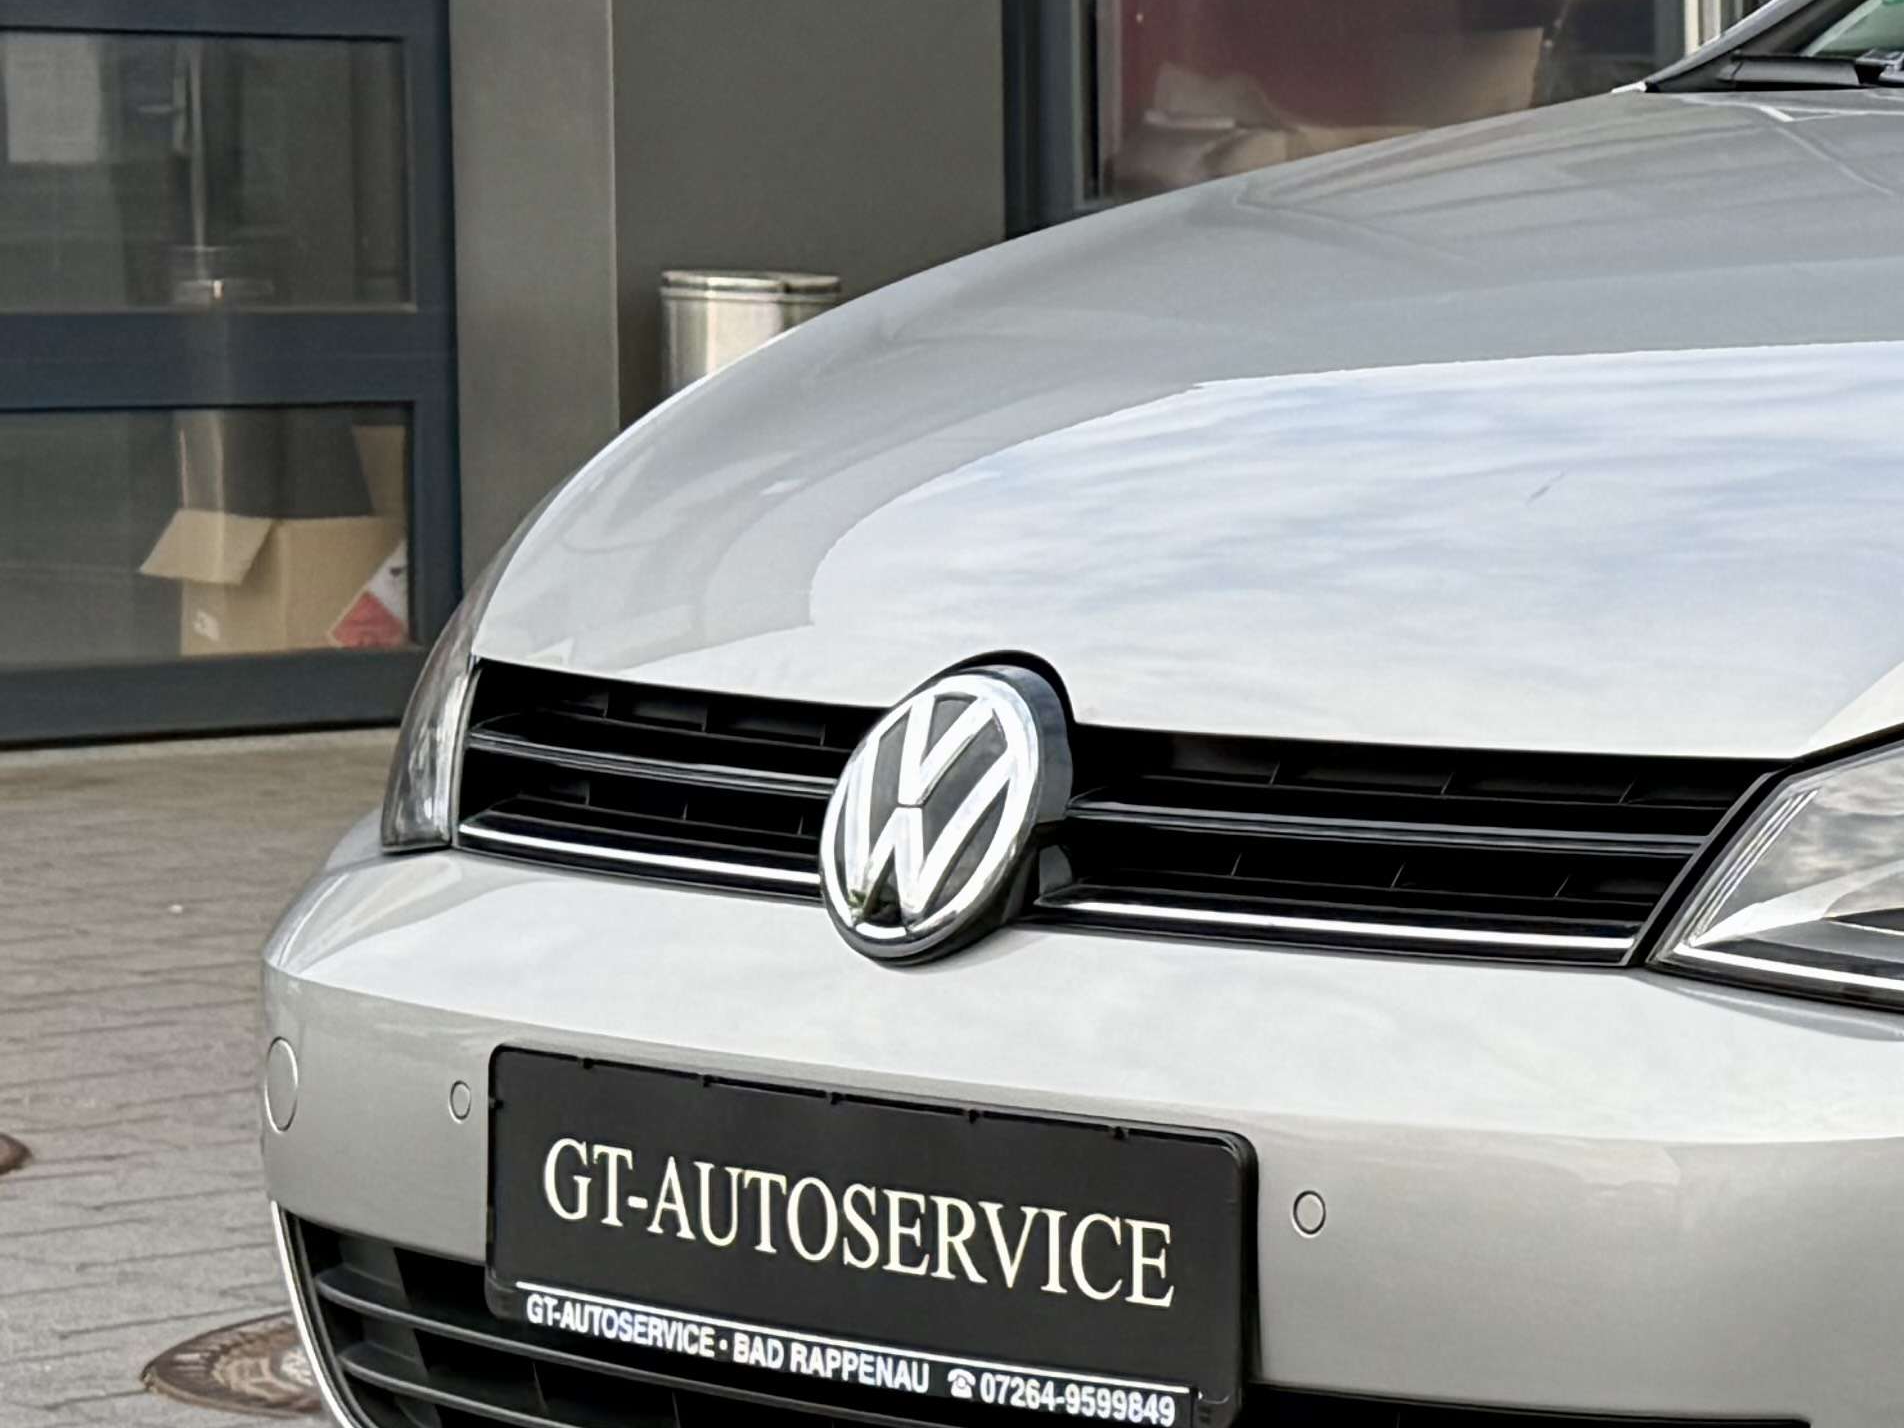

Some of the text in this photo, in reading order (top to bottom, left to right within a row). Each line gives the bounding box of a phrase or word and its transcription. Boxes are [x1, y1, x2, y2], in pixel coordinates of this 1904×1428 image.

[828, 680, 1032, 938] VW
[543, 1137, 1176, 1308] GT-AUTOSERVICE
[525, 1293, 1177, 1428] GT-AUTOSERVICE BAD RAPPENAU 07264-9599849
